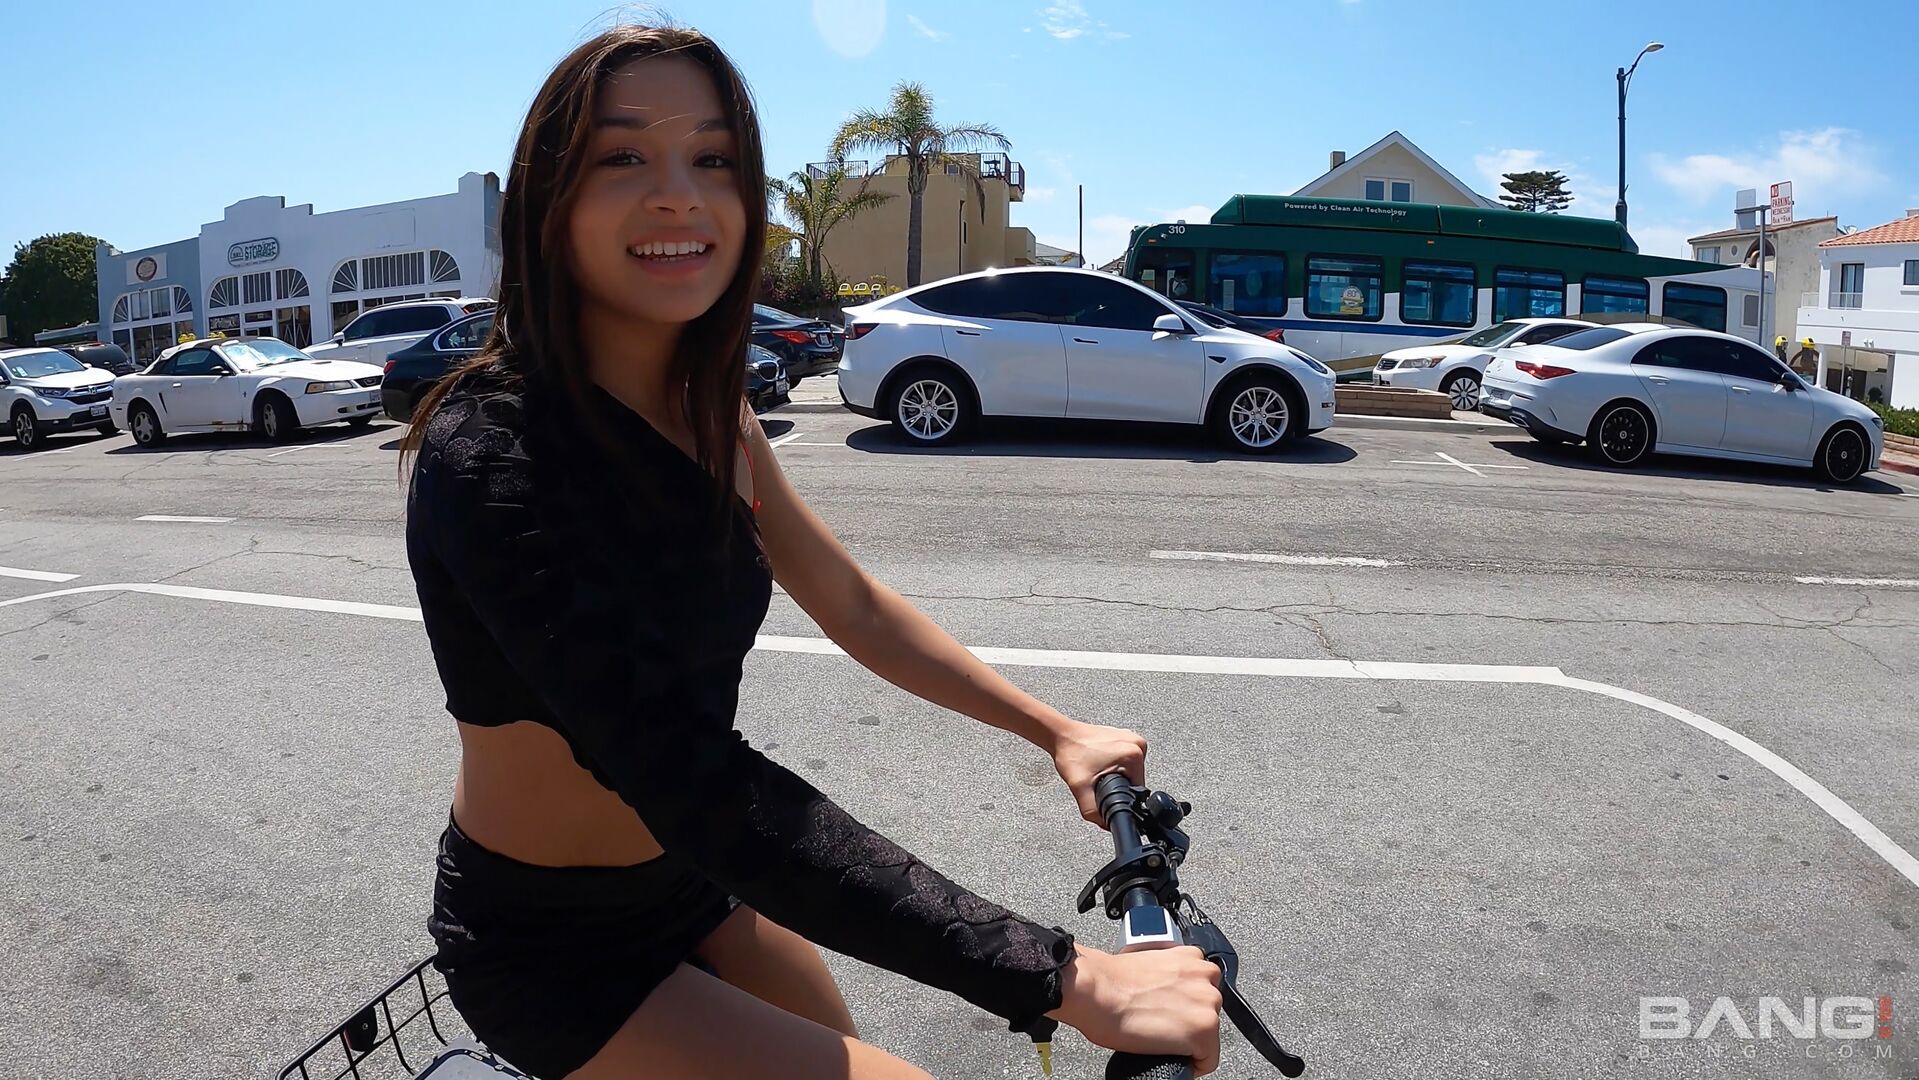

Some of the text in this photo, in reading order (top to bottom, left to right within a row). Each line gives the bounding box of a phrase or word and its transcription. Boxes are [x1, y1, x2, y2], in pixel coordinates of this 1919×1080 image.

[1772, 196, 1791, 207] PARKING
[1284, 202, 1317, 210] Powered
[1366, 207, 1407, 216] Technology
[1168, 225, 1186, 234] 310
[244, 242, 276, 260] STORAGE
